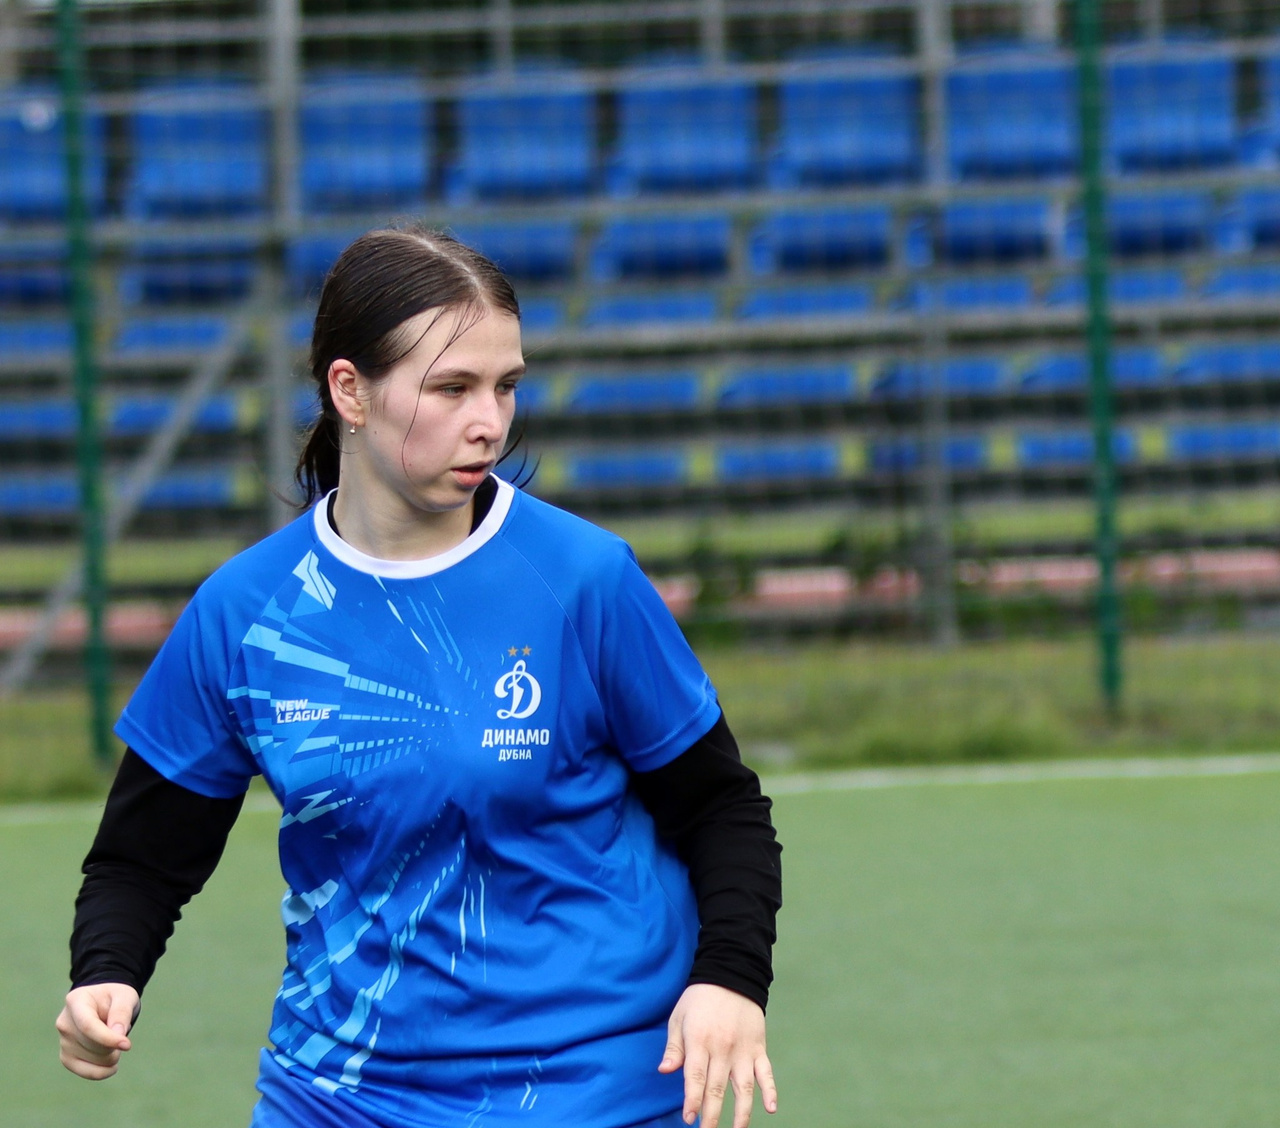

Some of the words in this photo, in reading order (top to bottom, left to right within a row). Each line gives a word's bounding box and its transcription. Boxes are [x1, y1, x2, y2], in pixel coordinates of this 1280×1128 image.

[275, 698, 309, 717] NEW
[276, 707, 332, 724] LEAGUE
[481, 728, 551, 748] ДИНАМО
[498, 748, 532, 762] ДУБНА
